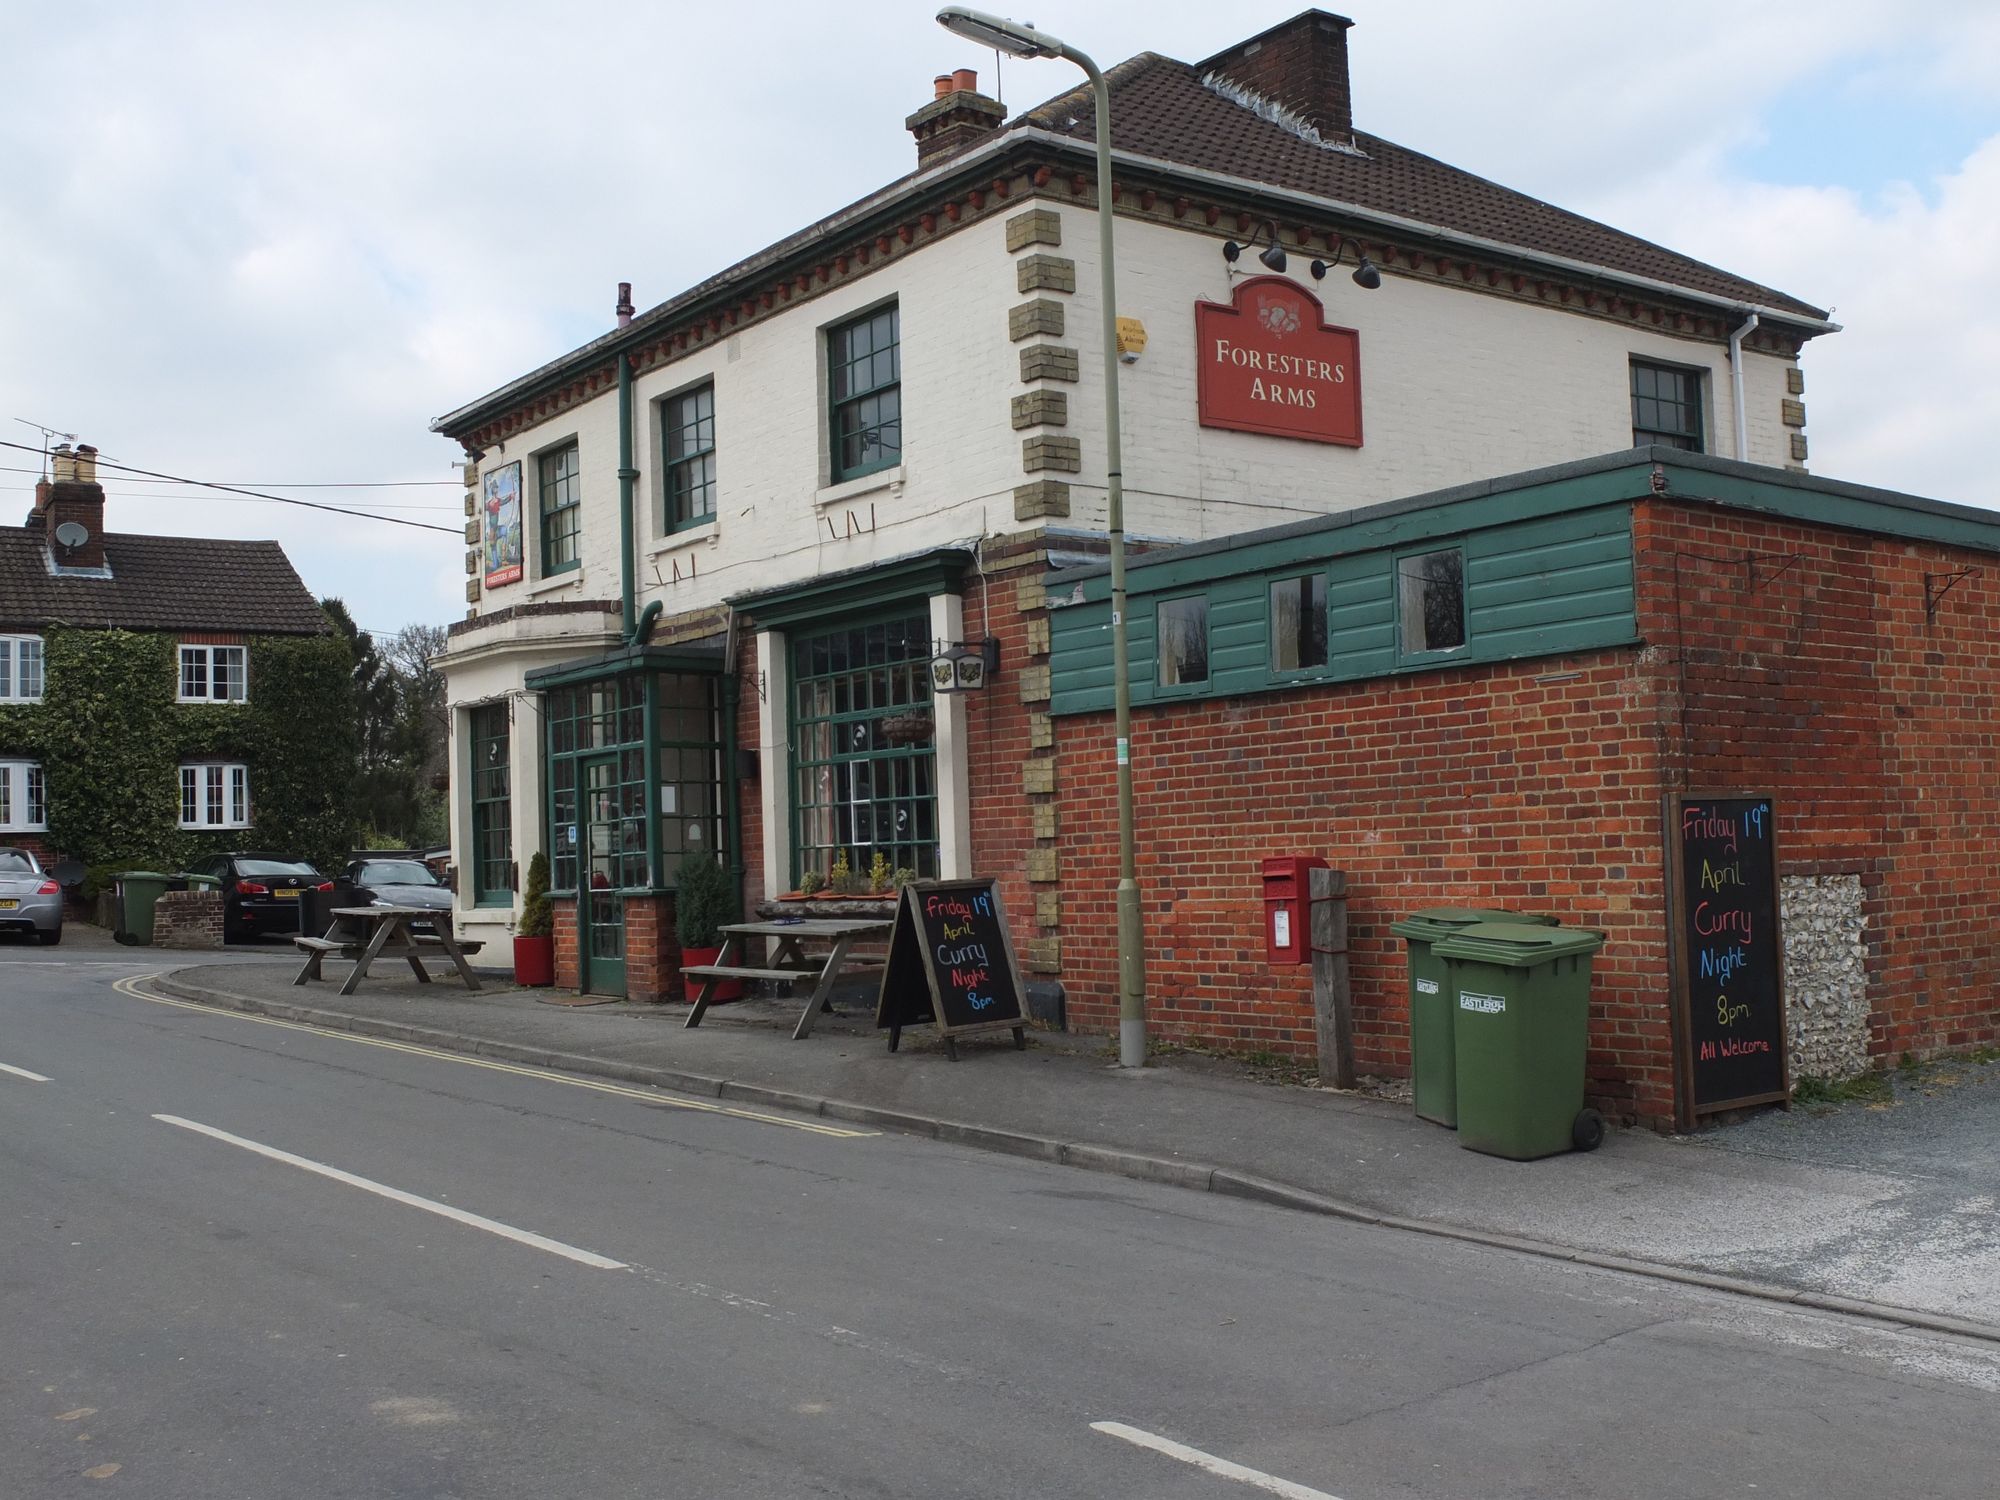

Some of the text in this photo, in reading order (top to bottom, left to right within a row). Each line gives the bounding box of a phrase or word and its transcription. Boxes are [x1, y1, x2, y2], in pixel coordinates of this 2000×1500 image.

[1215, 339, 1345, 384] FORESTERS
[1250, 376, 1317, 409] ARMS
[1682, 805, 1738, 856] Friday
[1701, 858, 1746, 893] April
[926, 895, 973, 923] Friday
[1695, 901, 1752, 944] Curry
[943, 922, 976, 940] April
[937, 943, 990, 967] Curry
[1701, 946, 1747, 986] Night
[952, 969, 990, 990] Night
[1700, 1037, 1769, 1060] All Welcome
